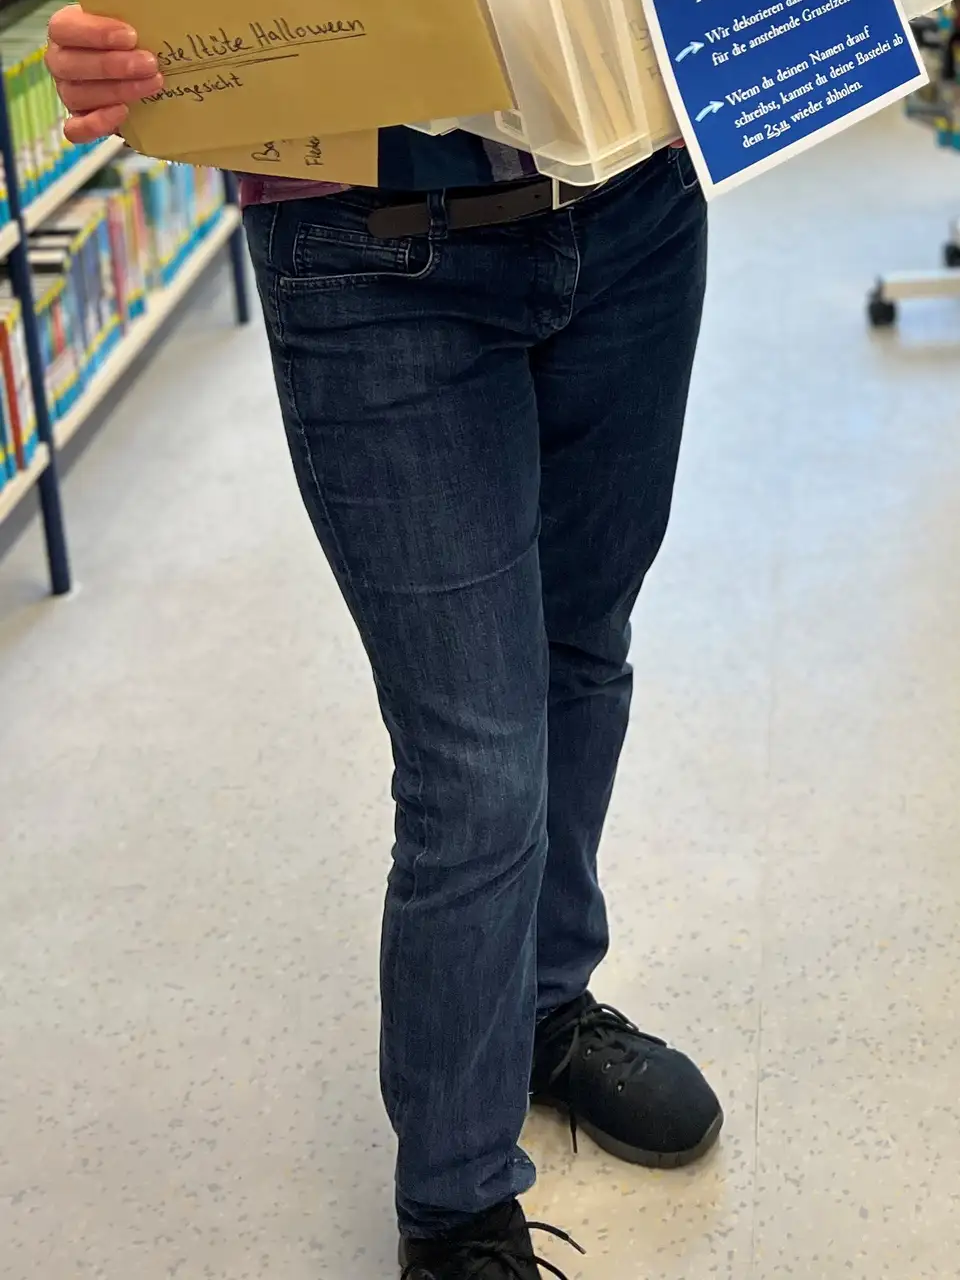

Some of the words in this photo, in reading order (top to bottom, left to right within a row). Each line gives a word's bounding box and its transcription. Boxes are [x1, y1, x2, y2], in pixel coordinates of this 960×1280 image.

[250, 17, 365, 48] Halloween
[704, 26, 731, 44] Wir
[732, 3, 784, 32] dekorieren
[711, 51, 730, 66] für
[732, 42, 747, 56] die
[749, 16, 801, 49] anstehende
[725, 85, 760, 106] Wenn
[761, 76, 776, 90] du
[776, 60, 809, 82] deinen
[809, 42, 845, 65] Namen
[846, 24, 871, 47] drauf
[734, 100, 781, 129] schreibst,
[779, 81, 814, 105] kannst
[815, 73, 828, 86] du
[829, 60, 855, 79] deine
[854, 40, 892, 66] Bastelei
[892, 33, 904, 48] ab
[742, 131, 764, 149] dem
[791, 100, 824, 123] wieder
[825, 79, 864, 106] abholen.
